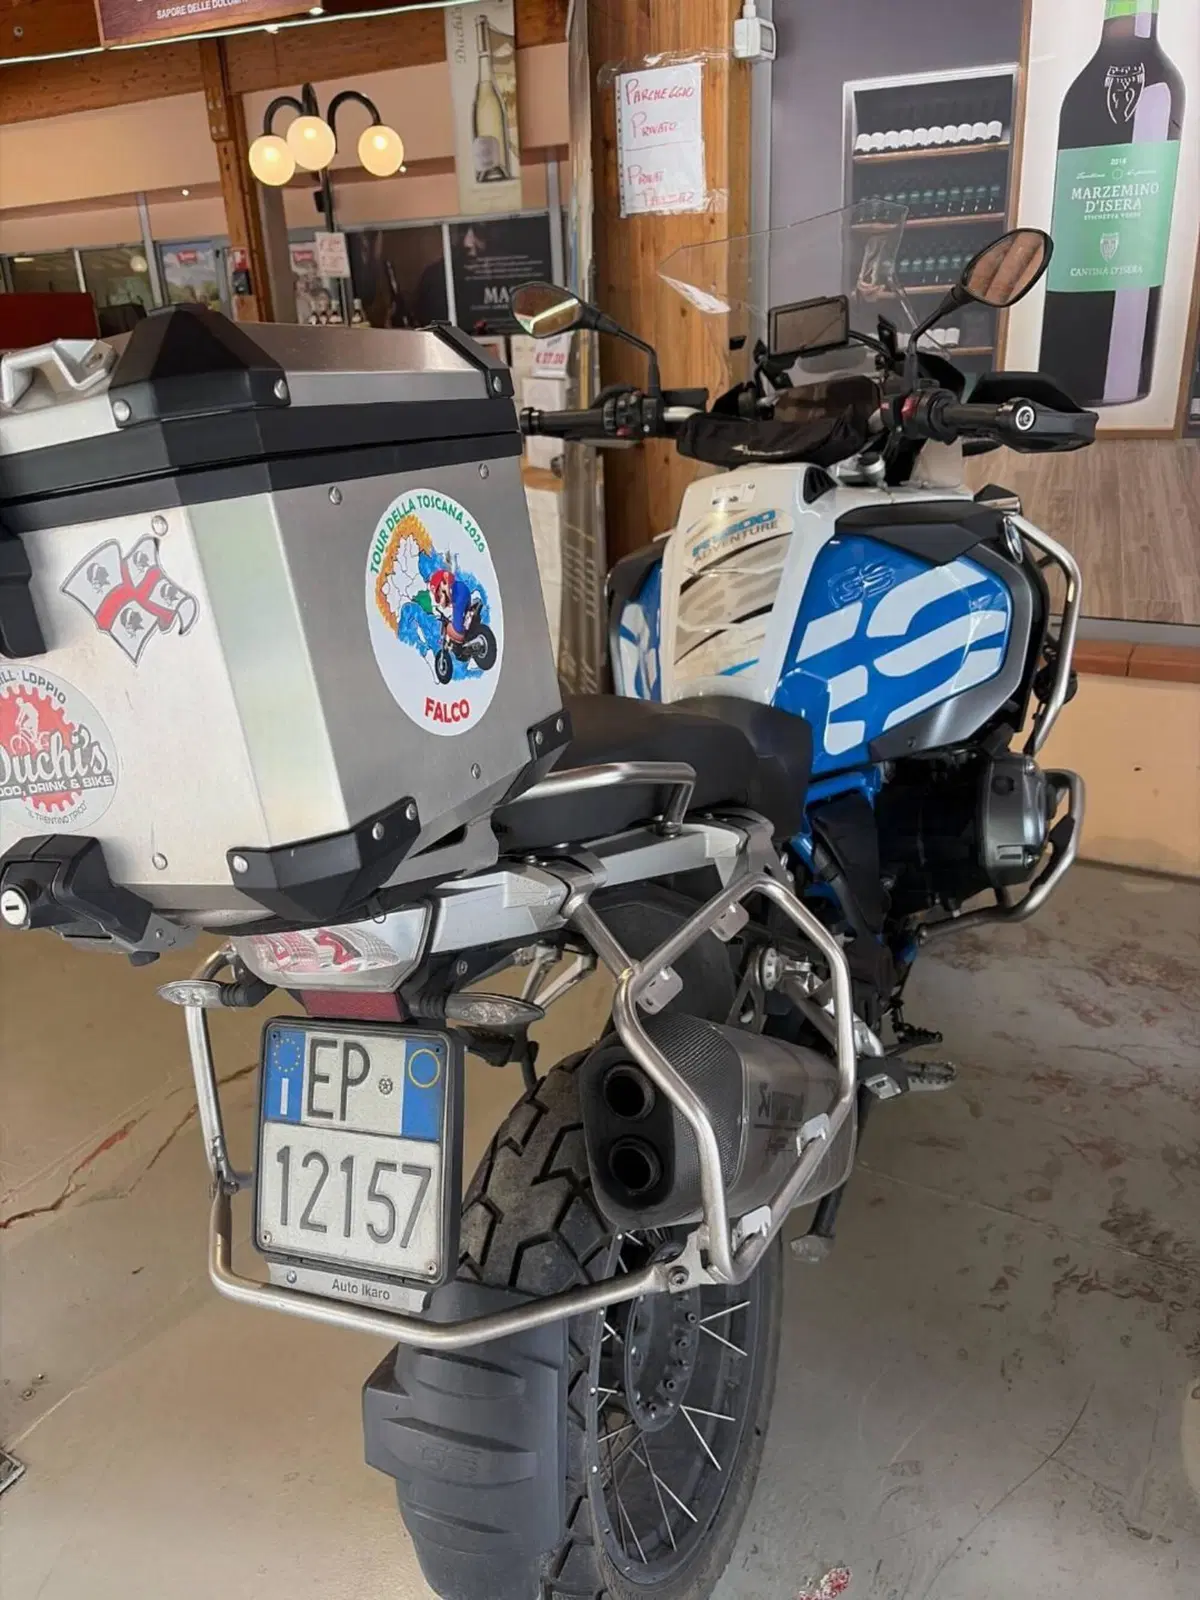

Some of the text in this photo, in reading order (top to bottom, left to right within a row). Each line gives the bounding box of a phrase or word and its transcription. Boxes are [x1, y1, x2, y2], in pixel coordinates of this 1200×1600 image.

[156, 9, 187, 20] SAPORE
[187, 2, 212, 16] DELLE
[625, 78, 695, 106] PARCHEGGIO
[631, 111, 677, 139] PRIVATO
[1071, 182, 1159, 200] MARZEMINO
[1085, 199, 1142, 214] D'ISERA
[1070, 265, 1109, 277] CANTINA
[484, 286, 510, 304] MA
[370, 495, 485, 574] TOUR DELLA TOSCANA 2020
[22, 670, 67, 704] LOPPIO
[424, 697, 470, 723] FALCO
[28, 780, 67, 794] DRINK
[70, 780, 79, 789] &
[83, 774, 113, 787] BIKE
[307, 1038, 371, 1122] EP
[277, 1145, 432, 1249] 12157
[331, 1278, 391, 1300] Auto Ikaro
